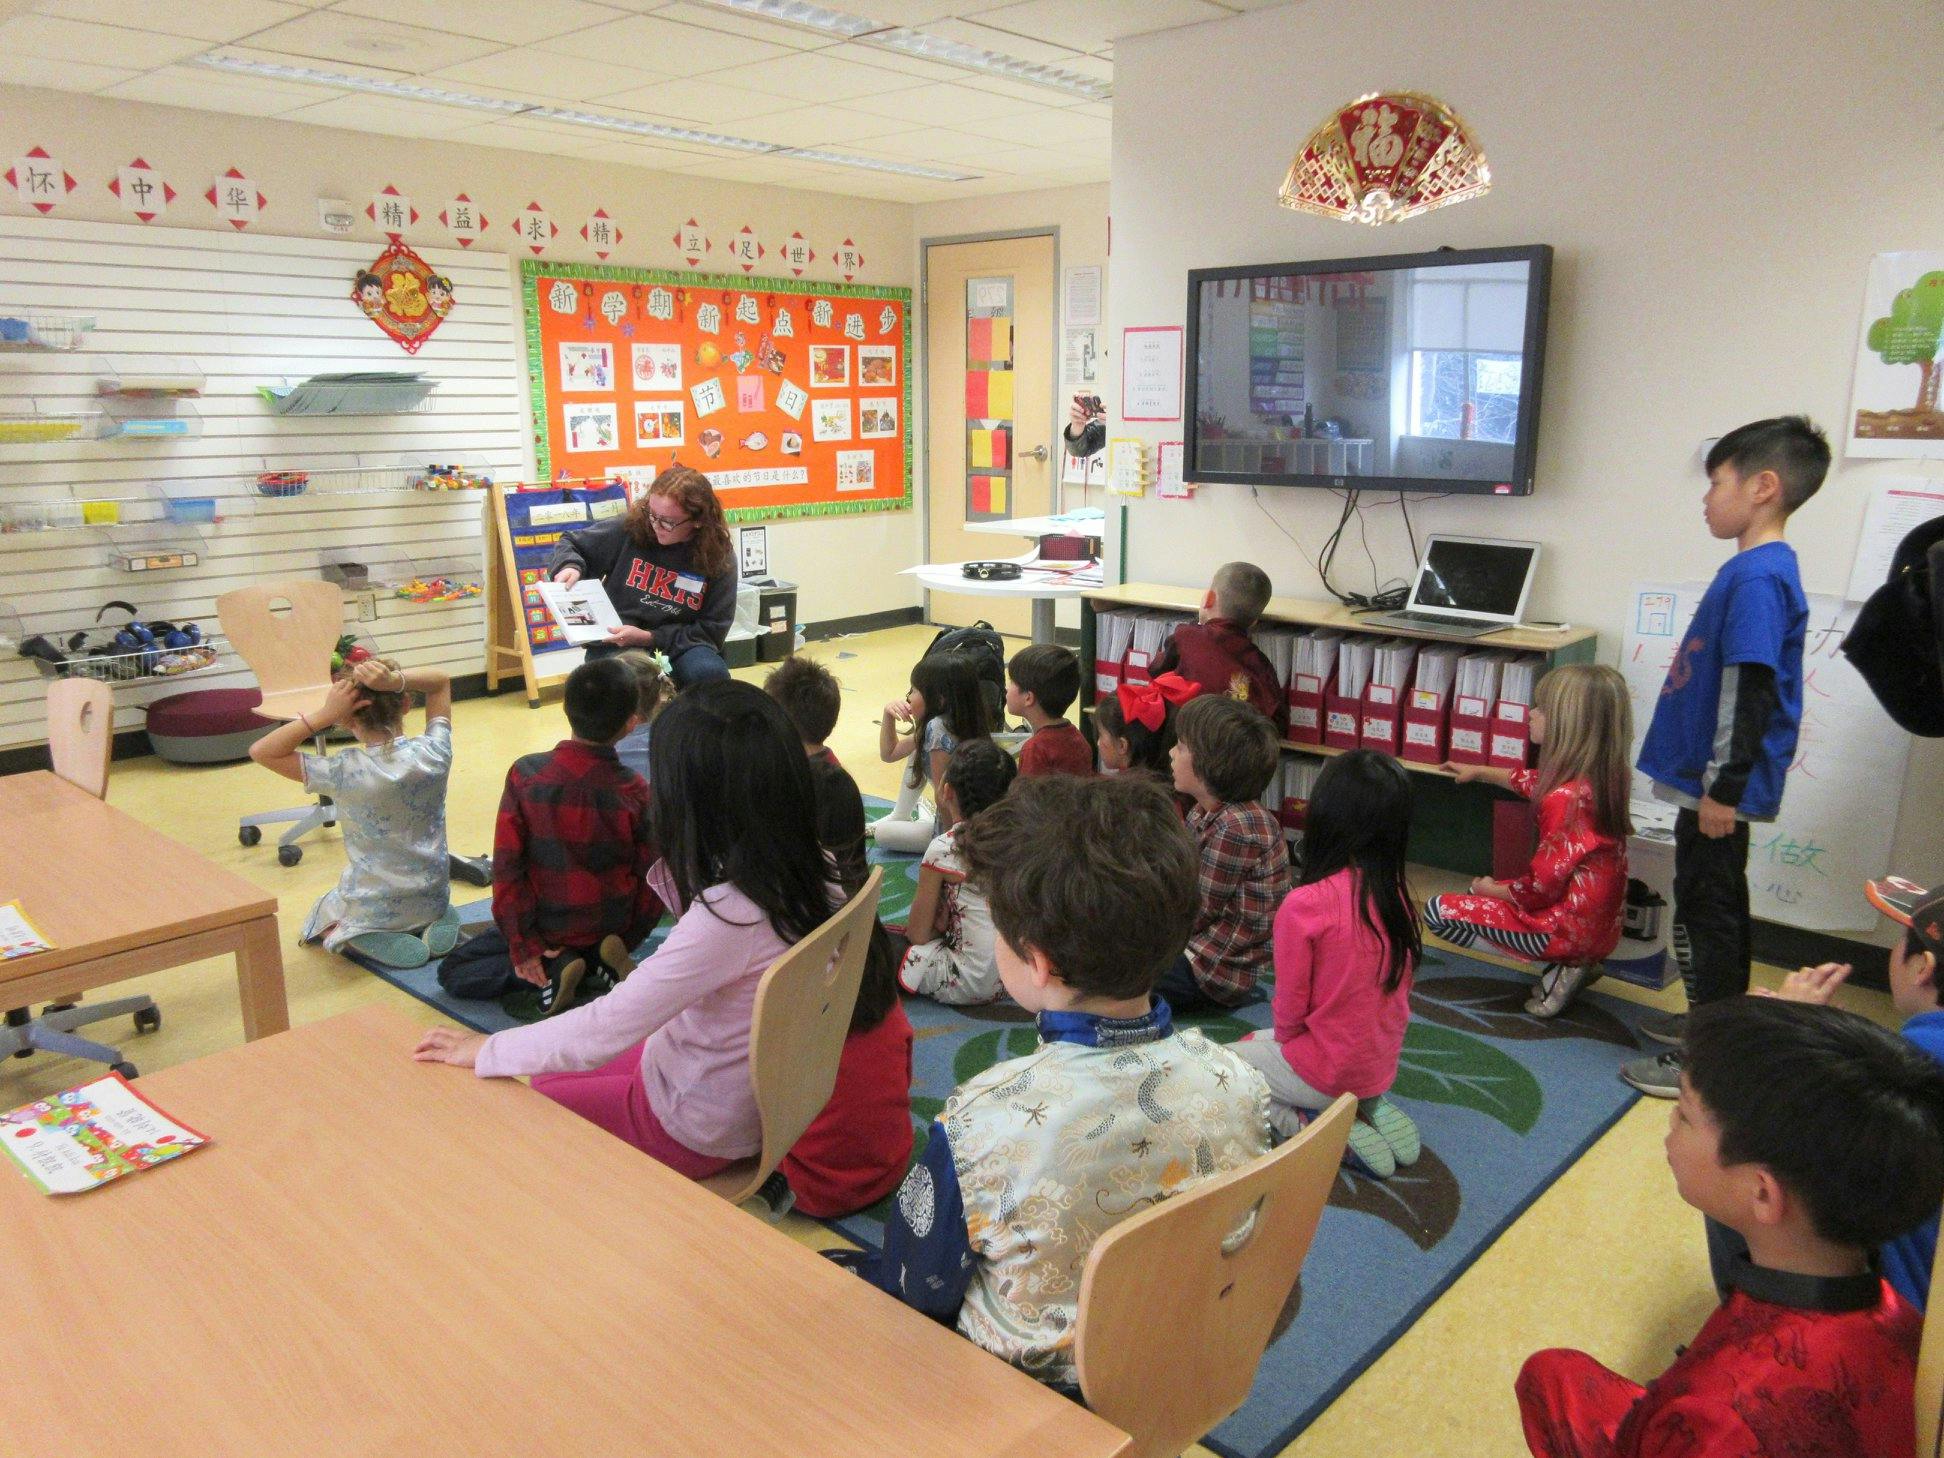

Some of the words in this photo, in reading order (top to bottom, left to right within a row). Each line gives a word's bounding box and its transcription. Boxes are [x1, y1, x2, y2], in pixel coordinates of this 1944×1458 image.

[707, 469, 805, 486] 最喜欢的节日是什么?
